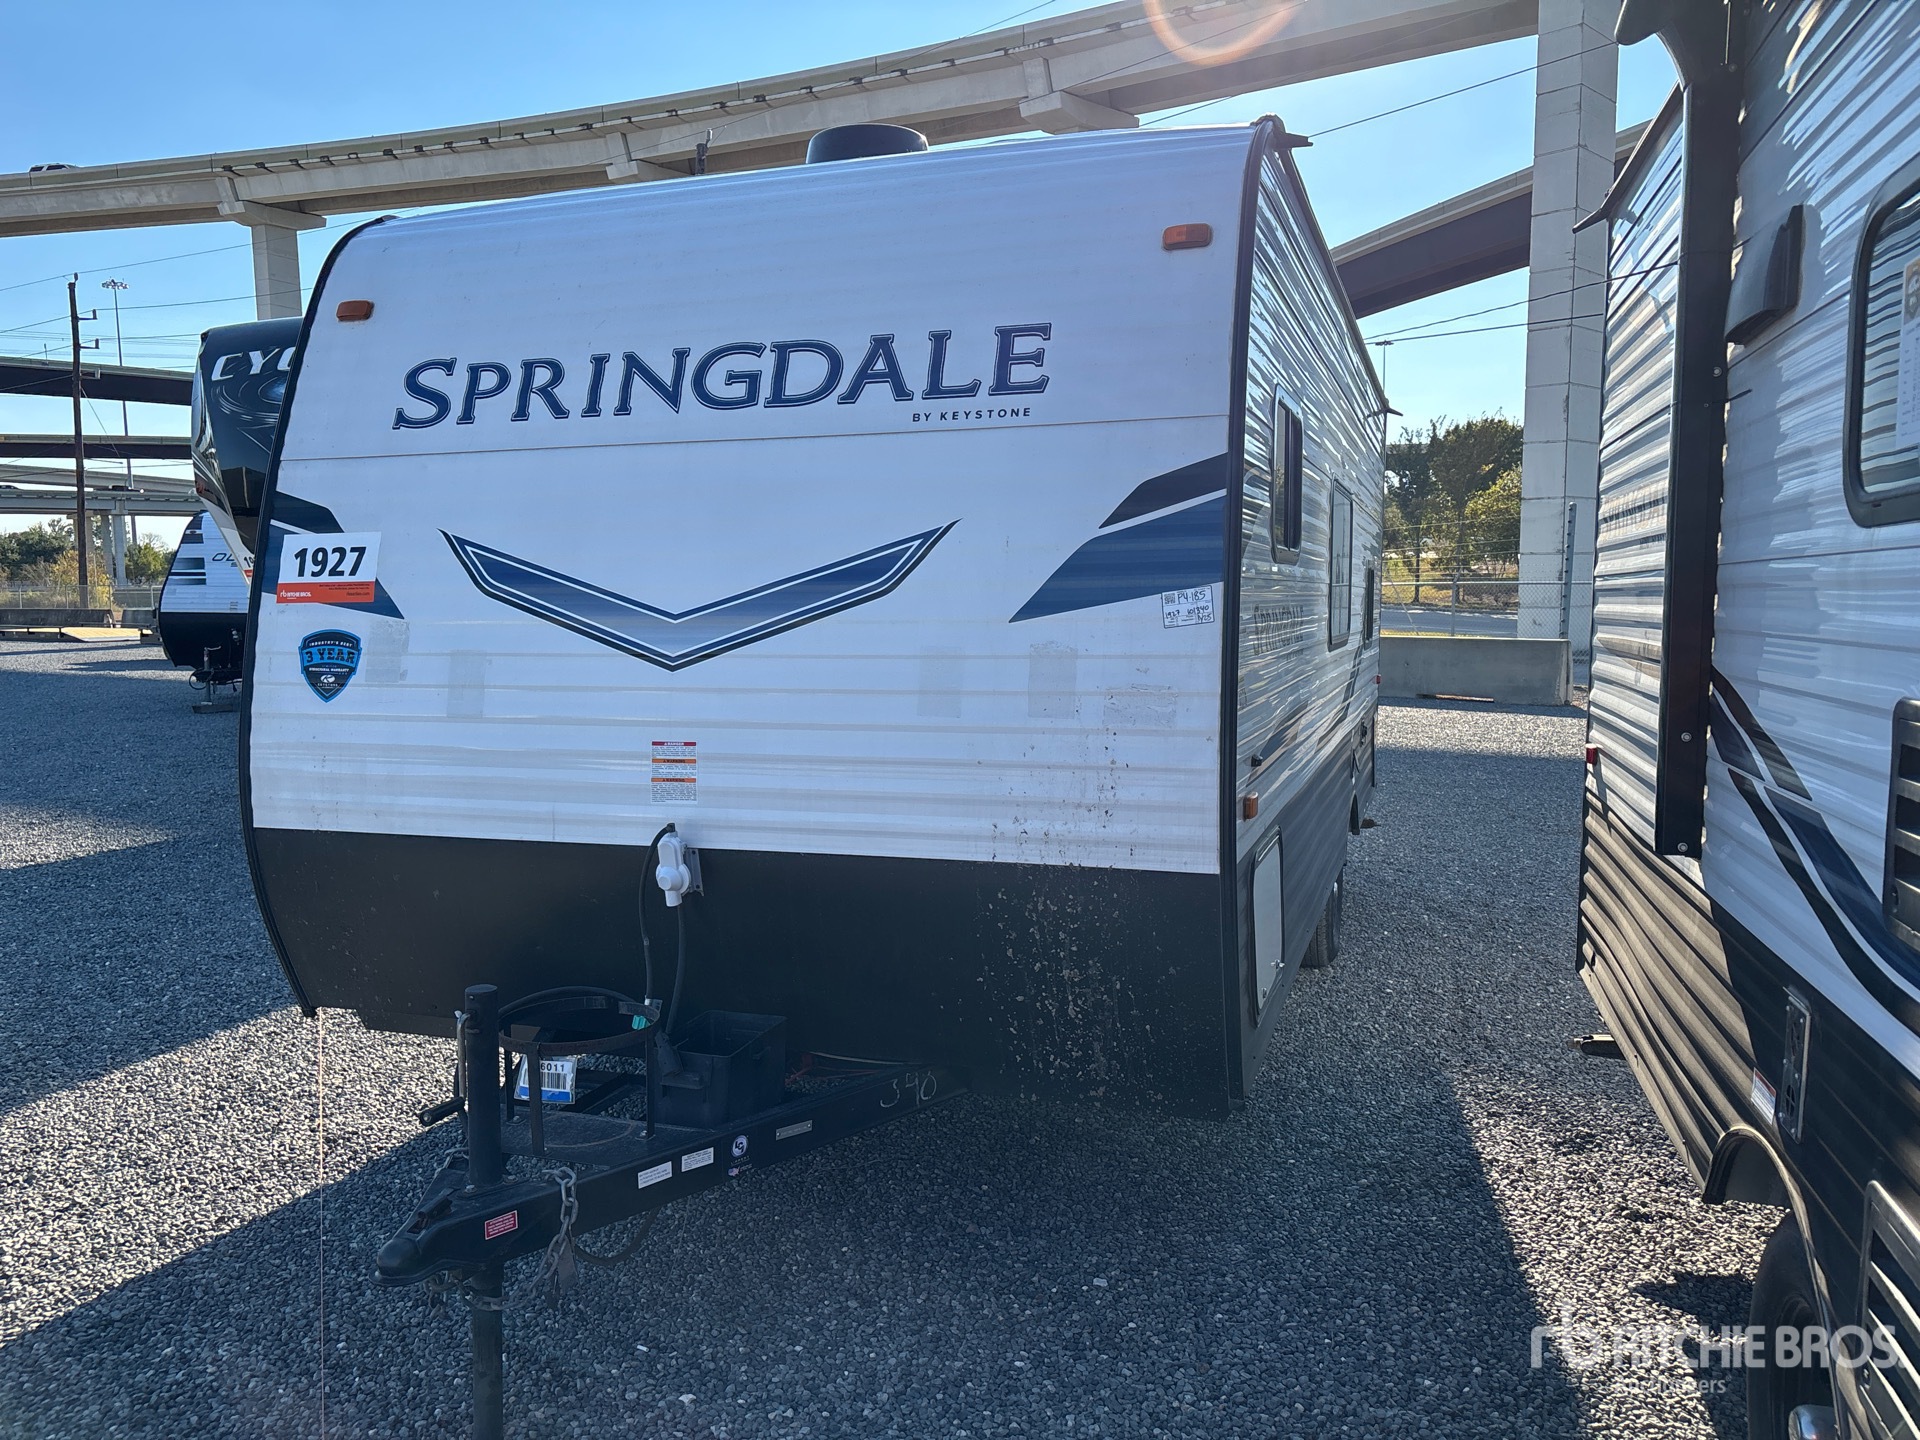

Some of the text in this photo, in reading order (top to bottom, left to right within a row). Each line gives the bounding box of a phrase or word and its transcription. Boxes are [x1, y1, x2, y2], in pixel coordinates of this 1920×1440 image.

[392, 322, 1052, 430] SPRINGDALE
[912, 403, 1031, 422] BY KEYSTONE
[294, 546, 367, 578] 1927
[305, 647, 355, 664] 3 YEAR
[541, 1062, 565, 1073] 6011
